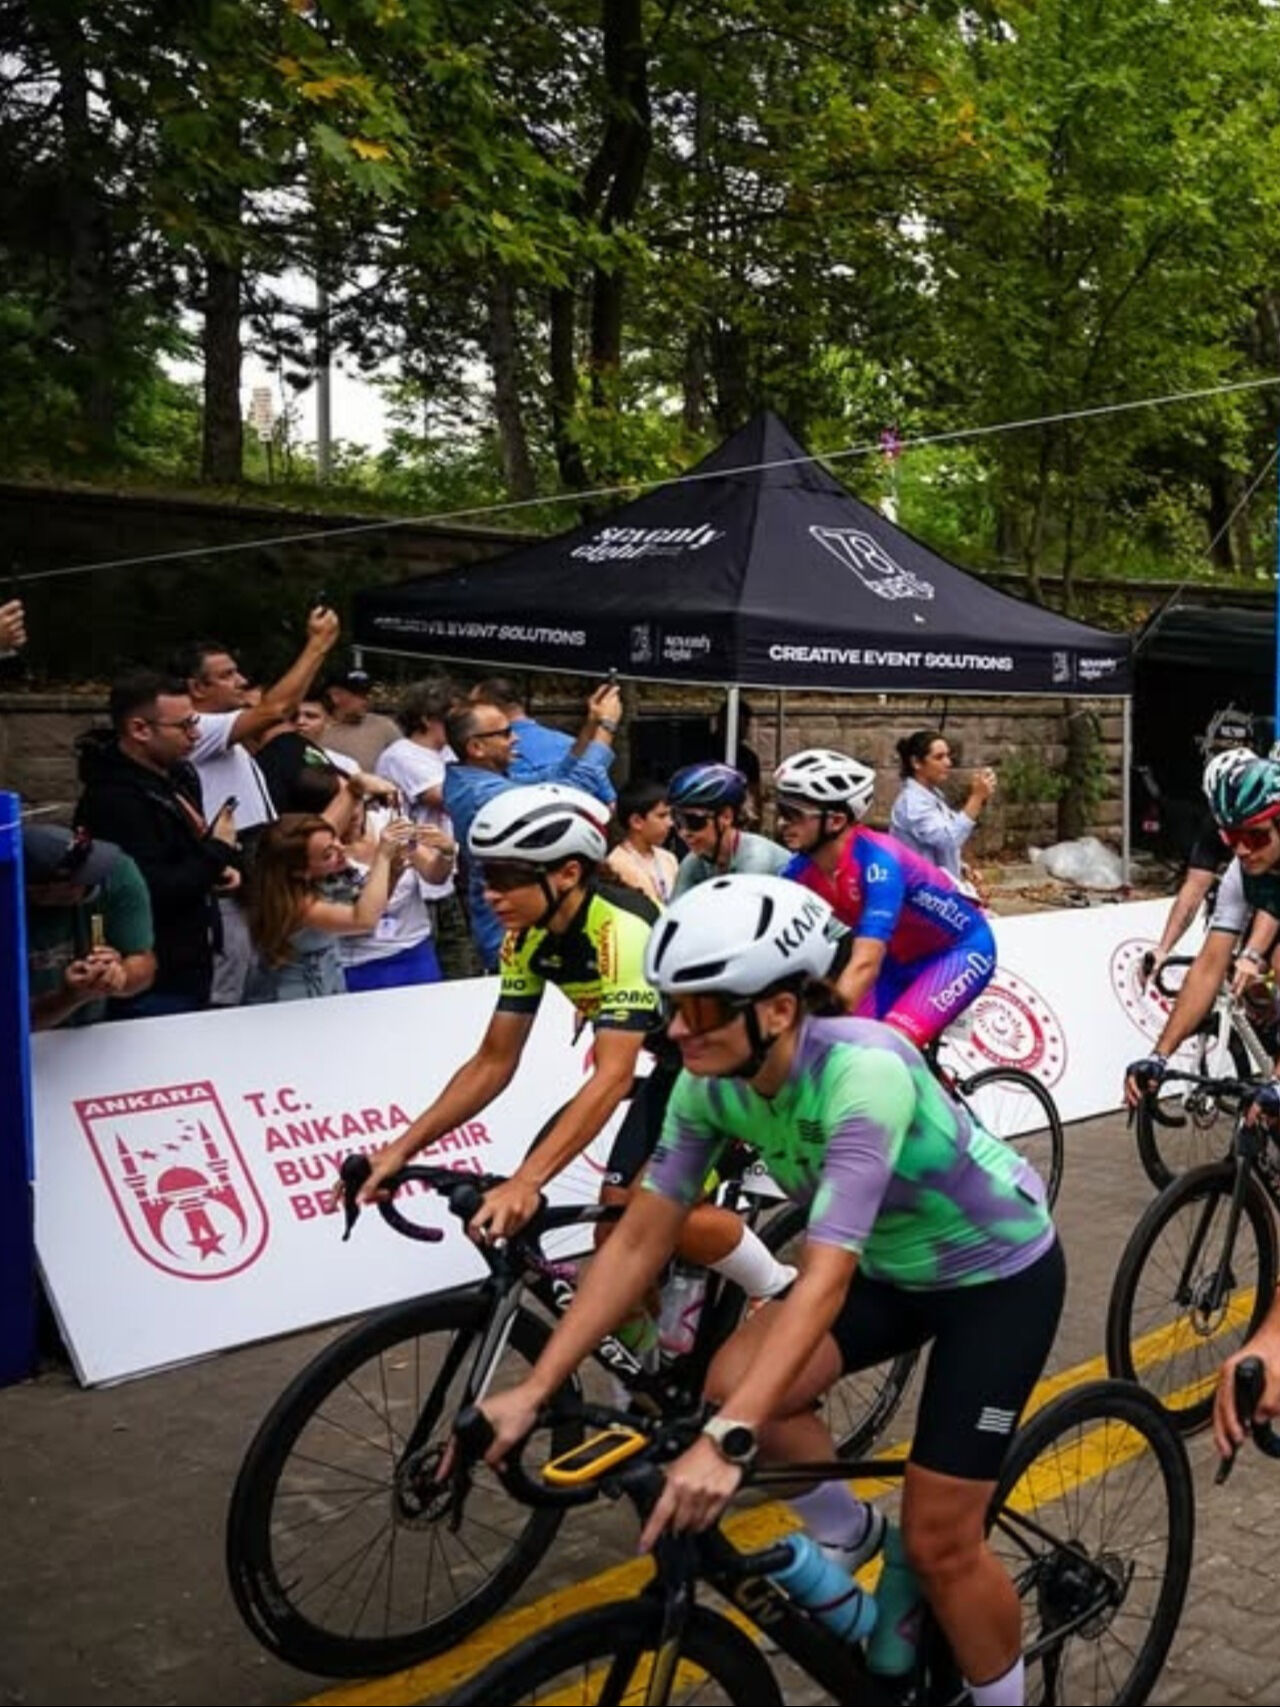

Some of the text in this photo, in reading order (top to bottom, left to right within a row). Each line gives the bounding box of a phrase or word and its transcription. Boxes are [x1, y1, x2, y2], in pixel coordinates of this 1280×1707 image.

[497, 626, 587, 647] SOLUTIONS
[769, 645, 1014, 672] CREATIVE EVENT SOLUTIONS
[84, 1086, 210, 1117] ANKARA
[243, 1087, 312, 1118] T.C.
[265, 1103, 414, 1152] ANKARA
